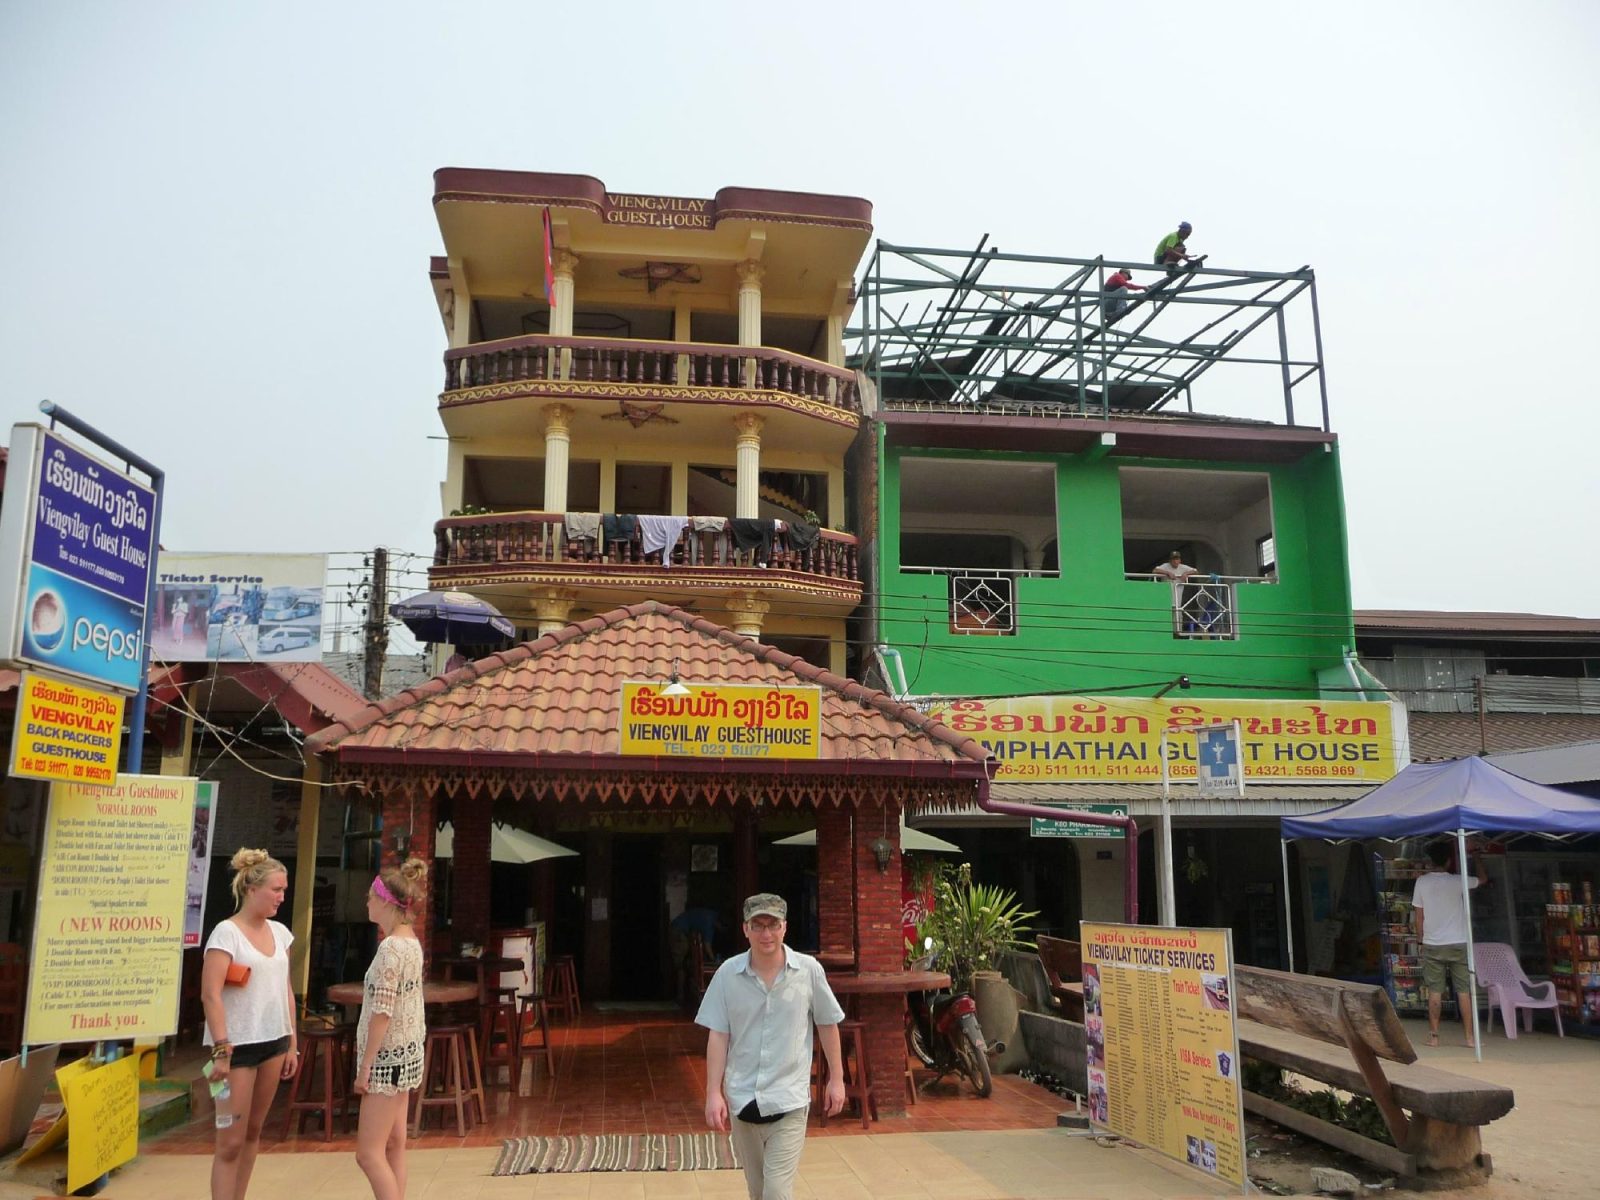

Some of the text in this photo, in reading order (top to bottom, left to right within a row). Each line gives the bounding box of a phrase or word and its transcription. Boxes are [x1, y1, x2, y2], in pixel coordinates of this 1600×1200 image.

[39, 495, 91, 548] Viengvilay
[92, 522, 119, 556] Guest
[120, 535, 147, 568] House
[160, 574, 264, 584] Ticket Service
[73, 617, 141, 662] pepsi
[31, 704, 115, 734] VIENGVILAY
[933, 700, 1149, 735] ຮືອນພັກ
[27, 723, 112, 748] BACK PACKERS
[629, 722, 812, 746] VIENGVILAY GUESTHOUSE
[32, 742, 107, 764] GUESTHOUSE
[701, 744, 726, 755] 023
[981, 741, 1147, 761] MPHATHAI
[1274, 742, 1380, 761] HOUSE
[1045, 764, 1068, 775] 511
[1106, 765, 1129, 775] 511
[1296, 766, 1327, 776] 5568
[129, 782, 178, 800] Guesthouse
[96, 803, 129, 817] NORMAL
[70, 915, 162, 932] NEW ROOMS
[1087, 943, 1215, 972] VIENGVILAY TICKET SERVICES
[70, 1012, 111, 1030] Thank
[1192, 1051, 1212, 1068] Service
